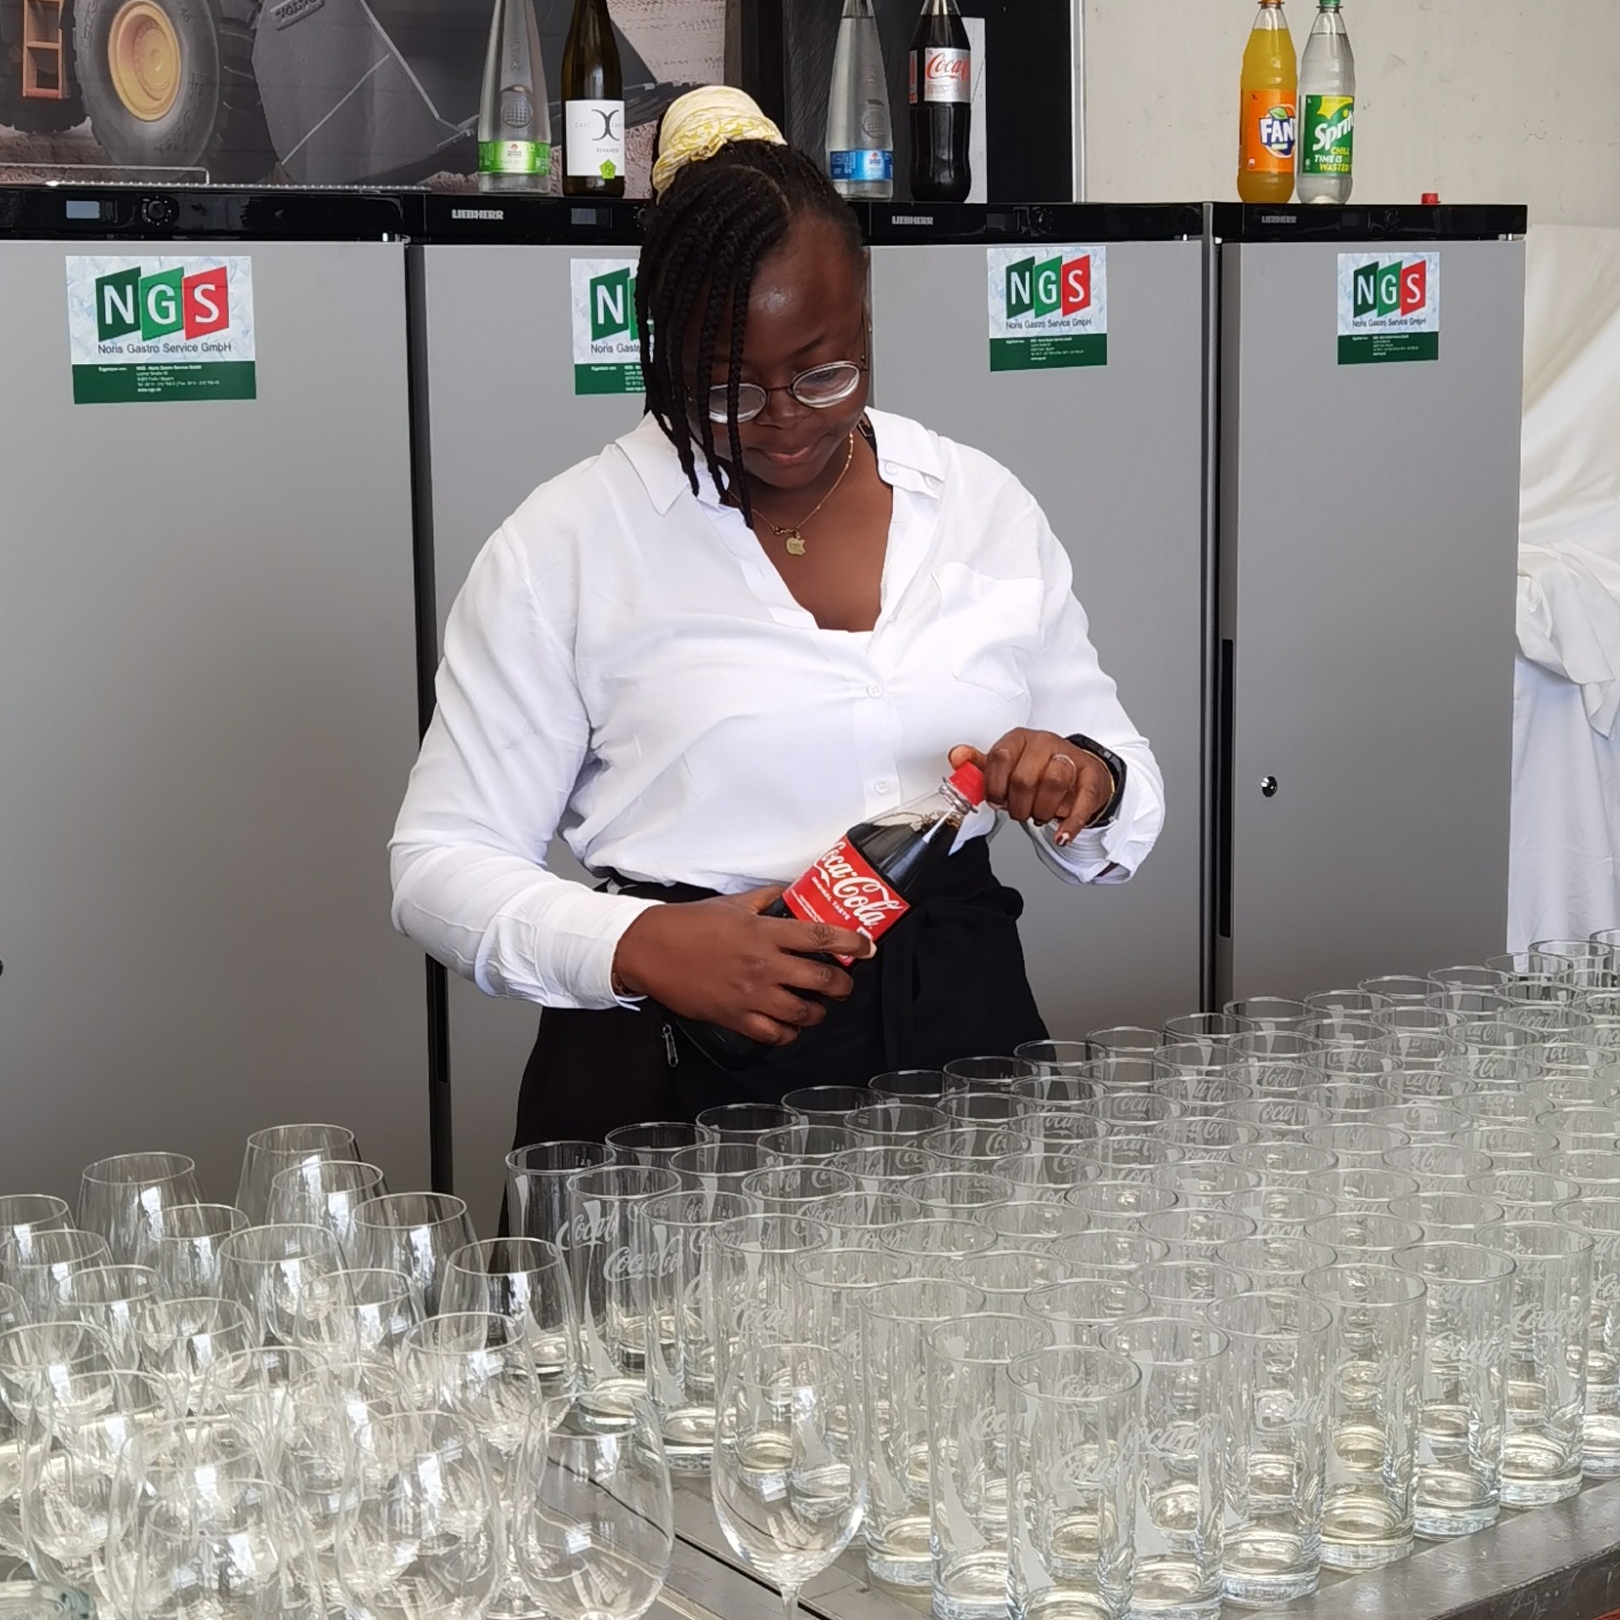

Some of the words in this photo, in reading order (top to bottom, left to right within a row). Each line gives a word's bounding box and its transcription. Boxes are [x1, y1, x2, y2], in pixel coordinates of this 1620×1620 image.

[1260, 116, 1294, 143] FAN
[1312, 110, 1354, 151] Sprit
[1314, 154, 1334, 163] TIME
[451, 209, 504, 220] LIEBHERR
[891, 215, 934, 225] LIEBHERR
[1261, 215, 1297, 224] LIEBHERR
[1010, 269, 1085, 305] NGS
[1357, 273, 1421, 305] NGS
[103, 283, 220, 325] NGS
[98, 344, 124, 354] Noris
[127, 343, 160, 354] Gastro
[163, 342, 198, 353] Service
[200, 342, 232, 353] GmbH
[590, 344, 614, 354] Noris
[616, 343, 640, 353] Gastr
